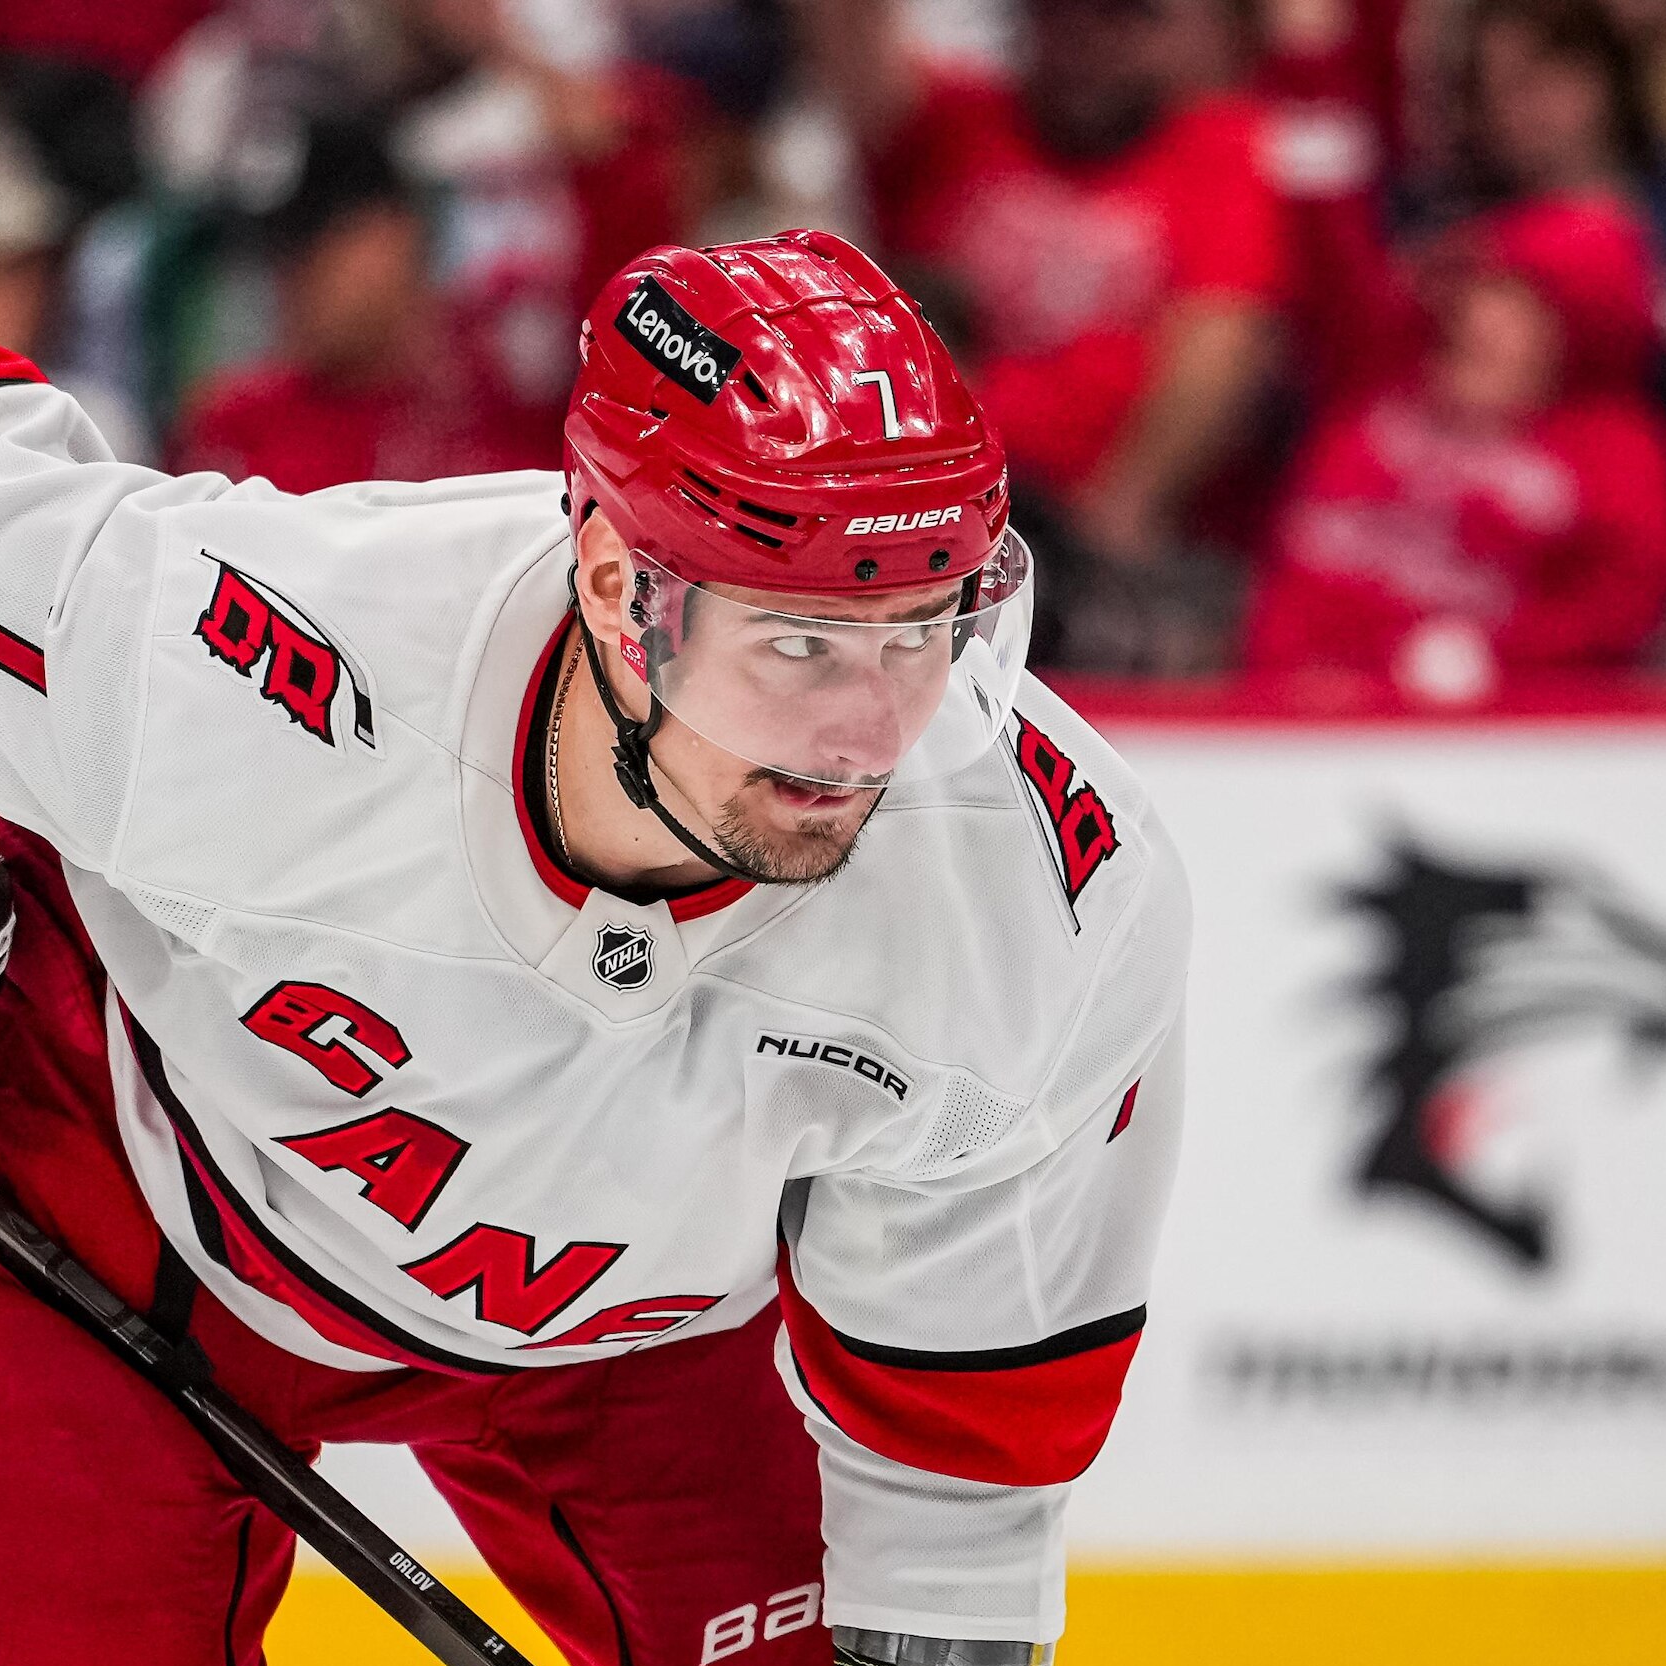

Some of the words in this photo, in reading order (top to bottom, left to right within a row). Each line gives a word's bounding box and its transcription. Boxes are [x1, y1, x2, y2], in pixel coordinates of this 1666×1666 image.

[625, 290, 719, 386] Lenovo
[852, 370, 901, 440] 7
[843, 504, 964, 536] BAUER
[604, 943, 644, 975] NHL
[755, 1033, 909, 1101] NUCOR
[389, 1551, 435, 1592] ORLOV
